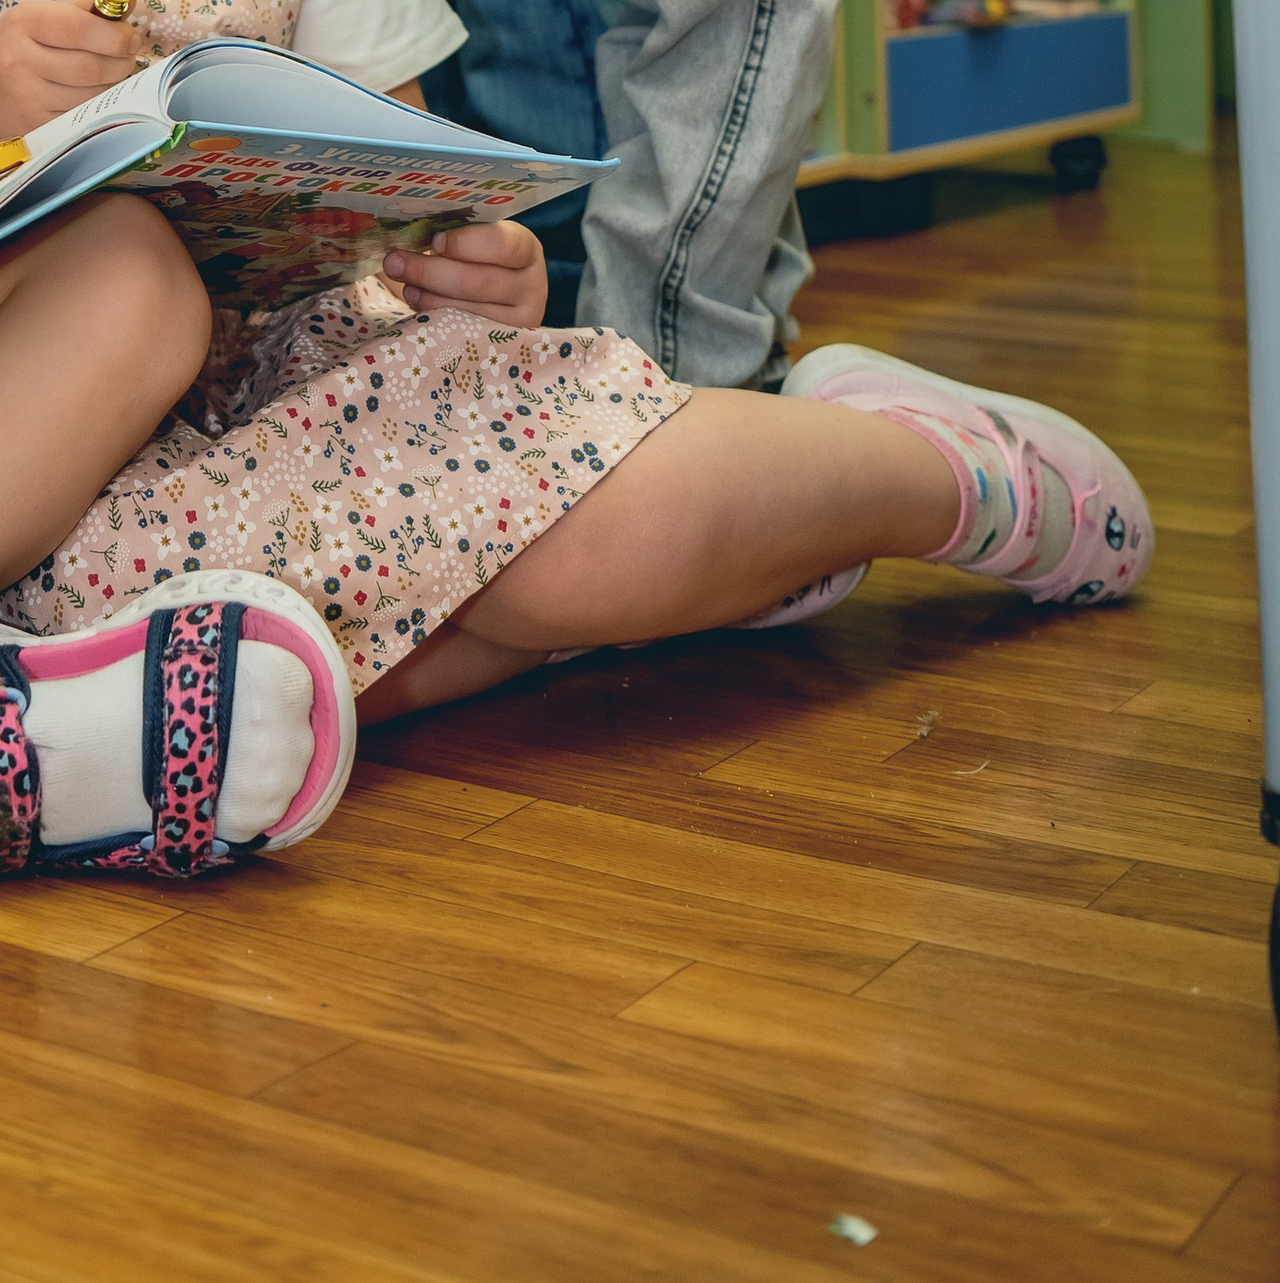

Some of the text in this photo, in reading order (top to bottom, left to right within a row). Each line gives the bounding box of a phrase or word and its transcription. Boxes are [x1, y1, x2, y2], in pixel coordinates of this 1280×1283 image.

[273, 143, 498, 174] Э. Успенский
[160, 163, 515, 205] ПРОСТОКВАШИНО
